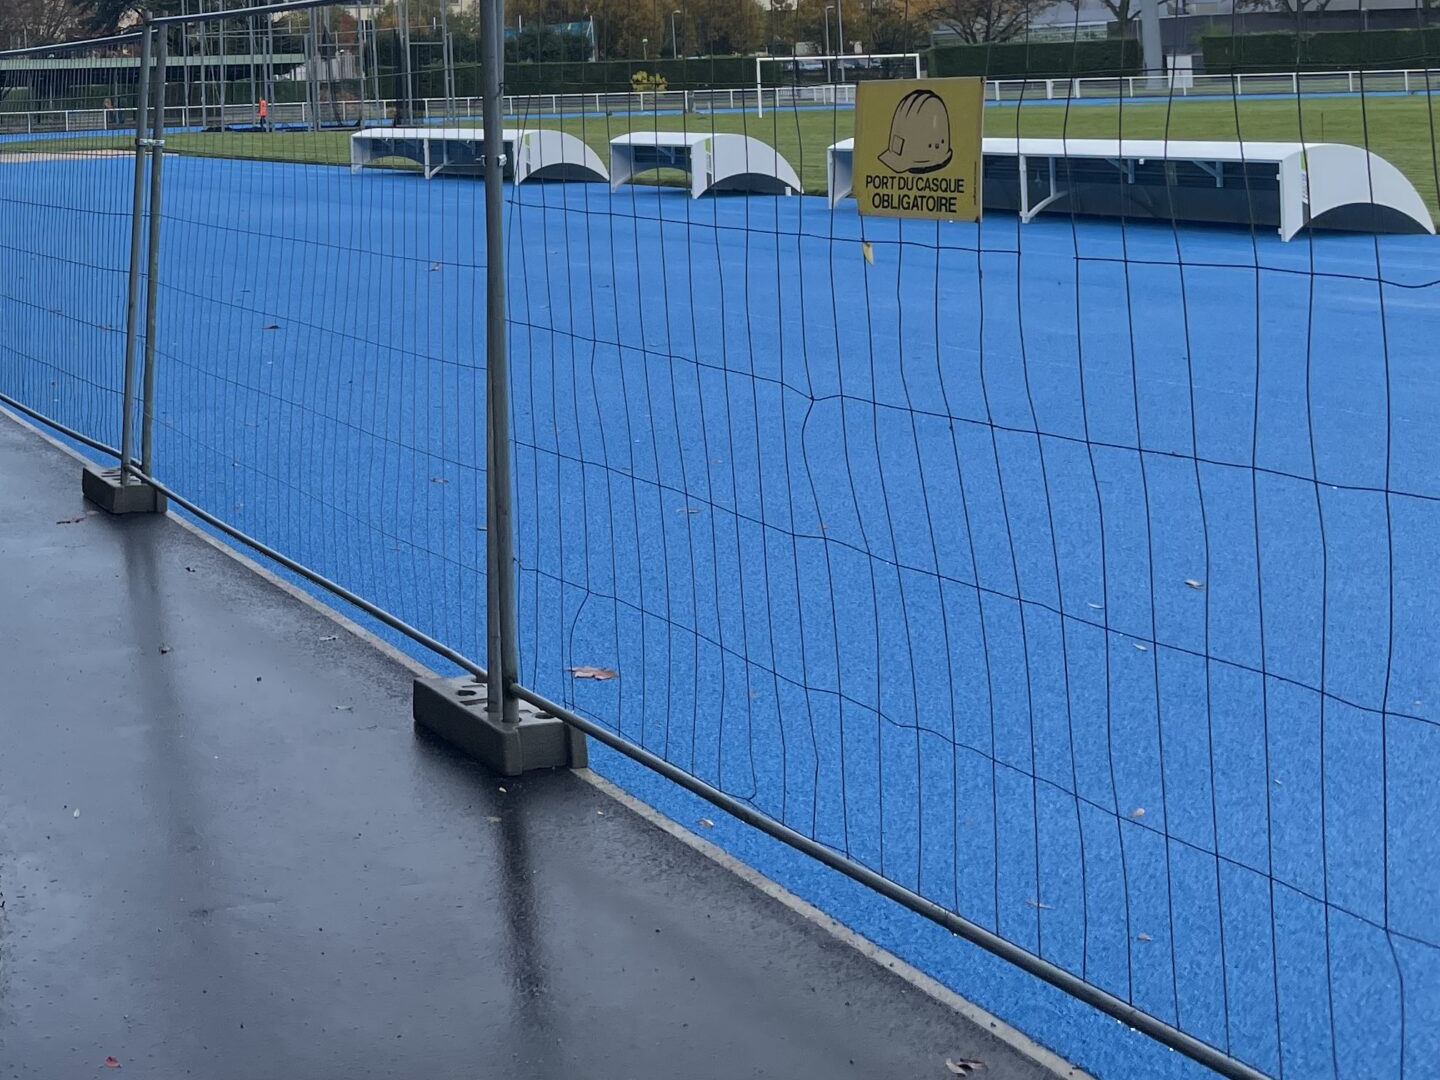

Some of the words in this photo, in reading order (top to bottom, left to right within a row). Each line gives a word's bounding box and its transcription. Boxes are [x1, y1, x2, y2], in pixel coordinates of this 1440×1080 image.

[865, 175, 897, 190] PORT
[898, 176, 915, 191] DU
[915, 177, 965, 193] CASQUE
[872, 192, 957, 213] OBLIGATOIRE
